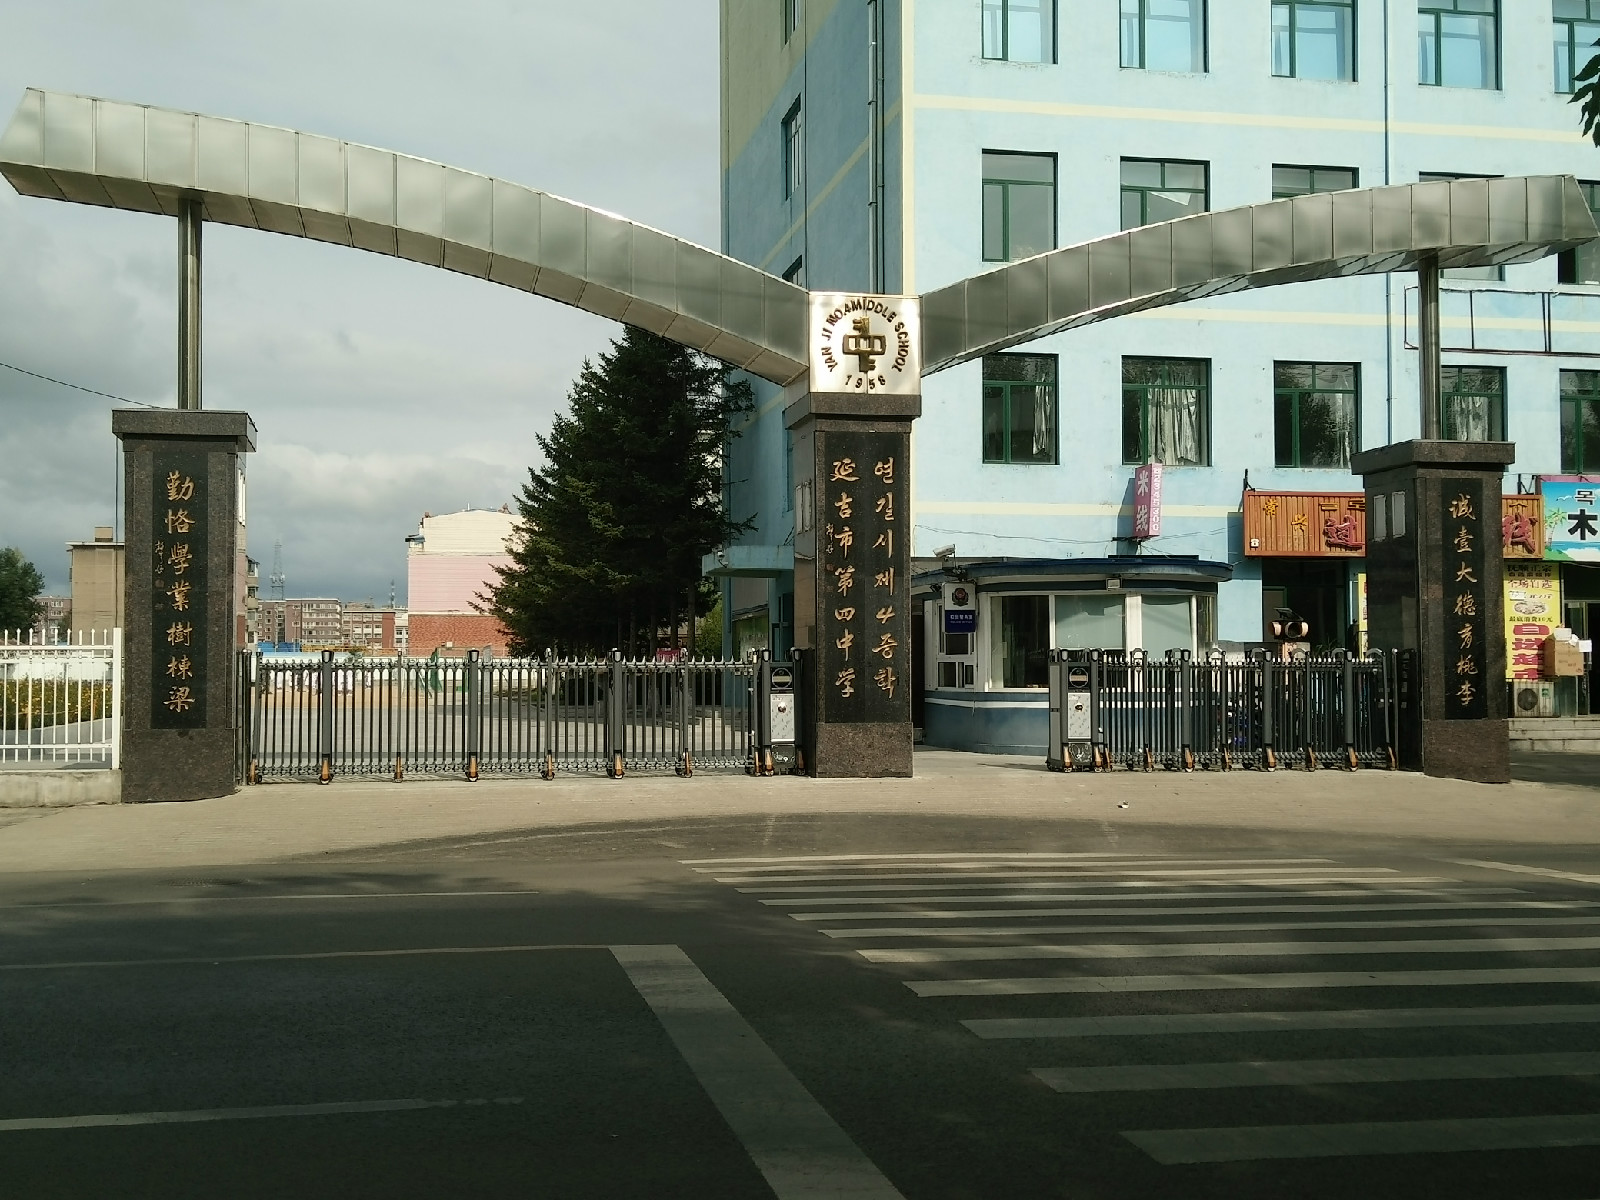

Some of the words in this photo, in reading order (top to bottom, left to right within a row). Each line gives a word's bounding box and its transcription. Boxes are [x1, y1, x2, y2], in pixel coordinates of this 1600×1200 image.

[892, 321, 910, 373] SCHOOL
[844, 373, 886, 390] 1956
[1136, 469, 1149, 532] 米线
[830, 458, 860, 698] 延吉市第四中学
